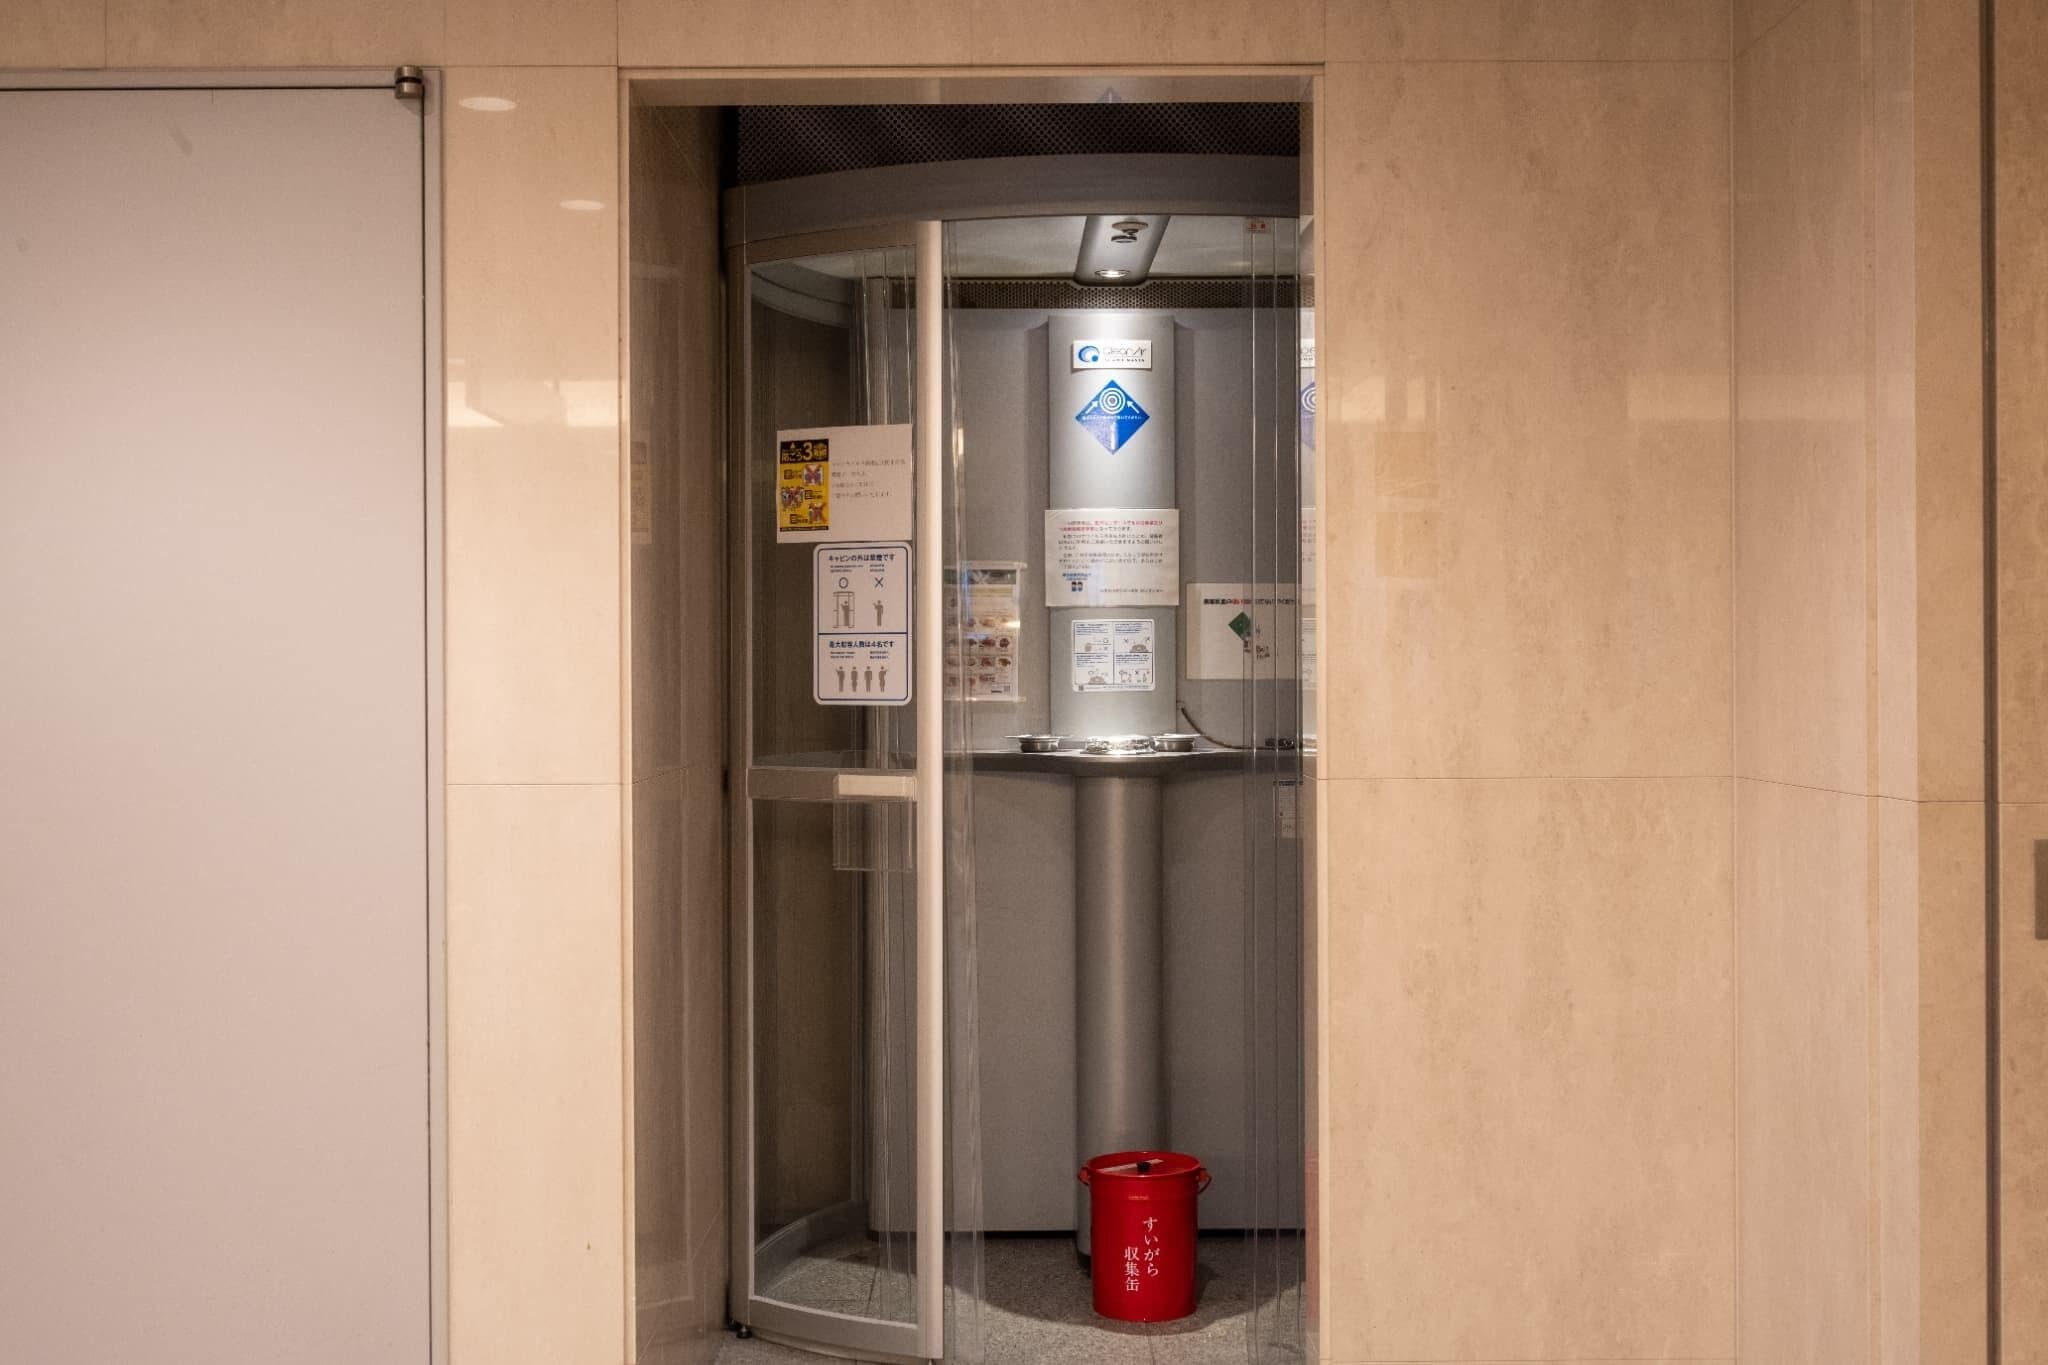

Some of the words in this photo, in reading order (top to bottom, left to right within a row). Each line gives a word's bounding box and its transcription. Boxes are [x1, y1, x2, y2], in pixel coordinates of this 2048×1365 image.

[1124, 1246, 1140, 1292] 収集缶
[1143, 1216, 1160, 1277] すいがら
